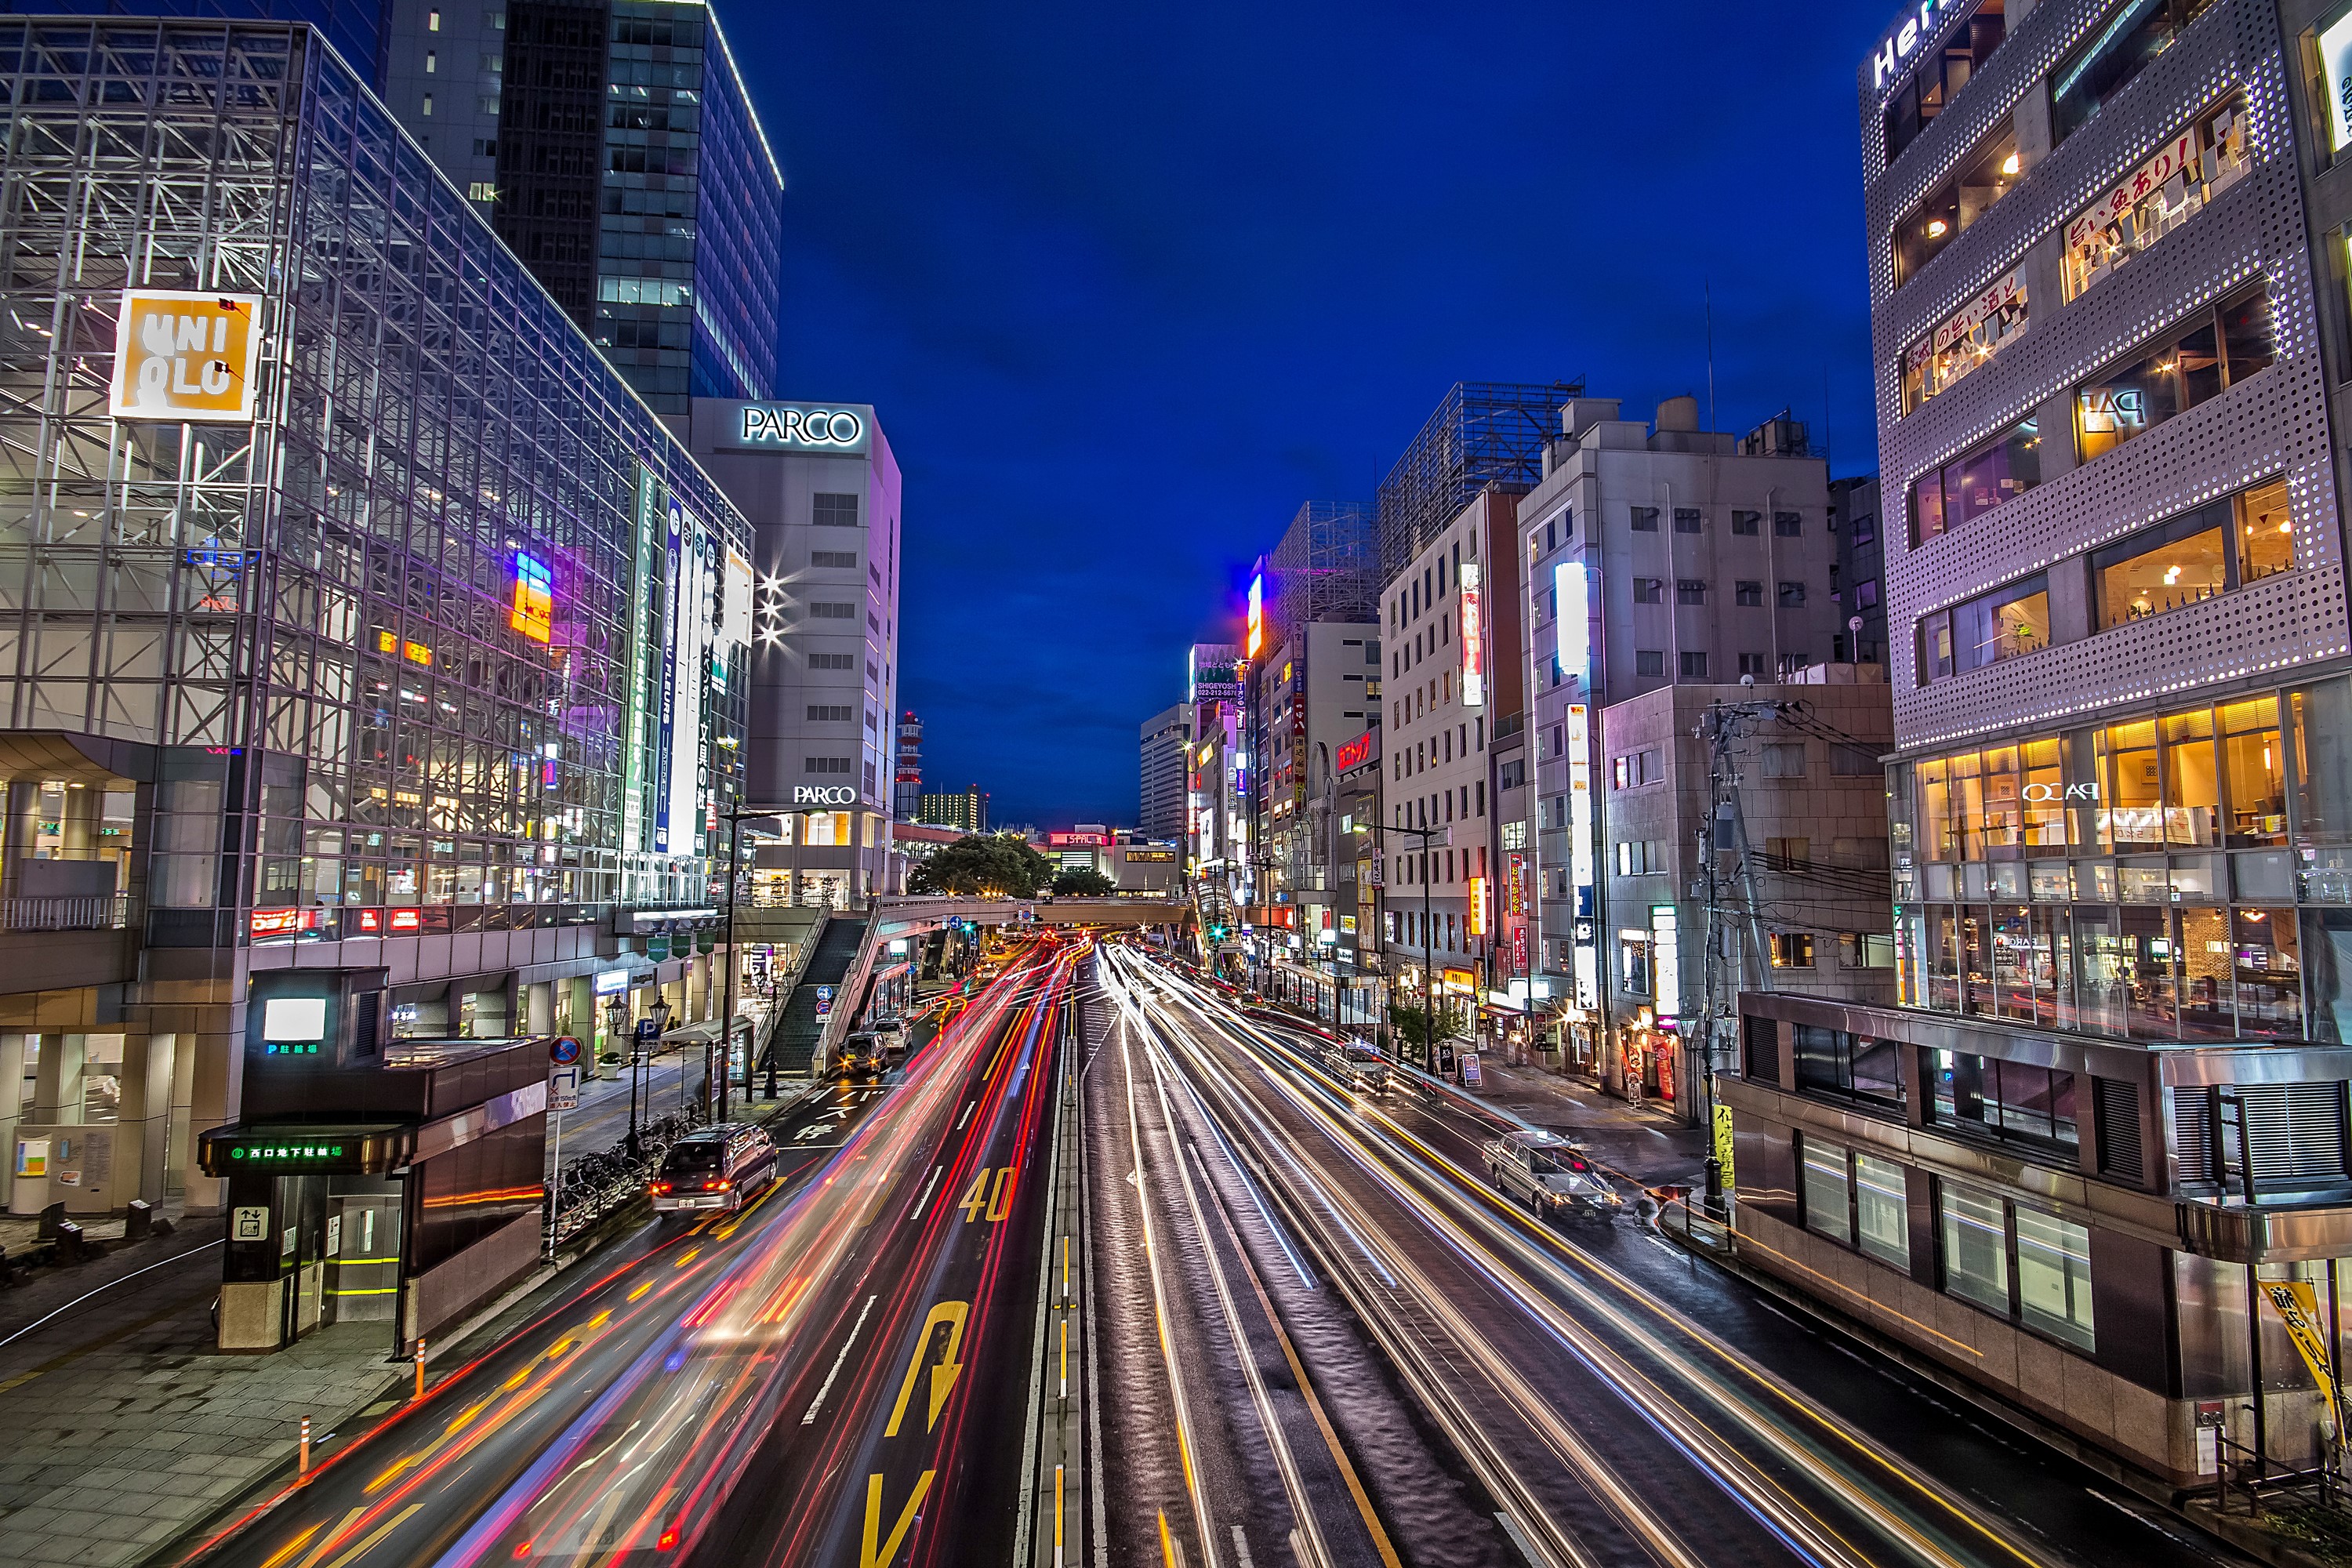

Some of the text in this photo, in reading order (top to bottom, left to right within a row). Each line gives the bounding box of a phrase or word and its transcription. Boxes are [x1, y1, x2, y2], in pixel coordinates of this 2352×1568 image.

[142, 313, 227, 355] UNI
[742, 408, 860, 443] PARCO
[665, 578, 676, 660] MONCEAU
[662, 662, 672, 725] FLEURS
[1294, 703, 1305, 729] つぼ八
[793, 786, 856, 805] PARCO
[1511, 866, 1519, 914] おたからや
[644, 1021, 656, 1034] P
[267, 1044, 318, 1054] P 駐輪場
[250, 1145, 343, 1157] 西口地下駐輪場
[959, 1167, 1015, 1223] 40
